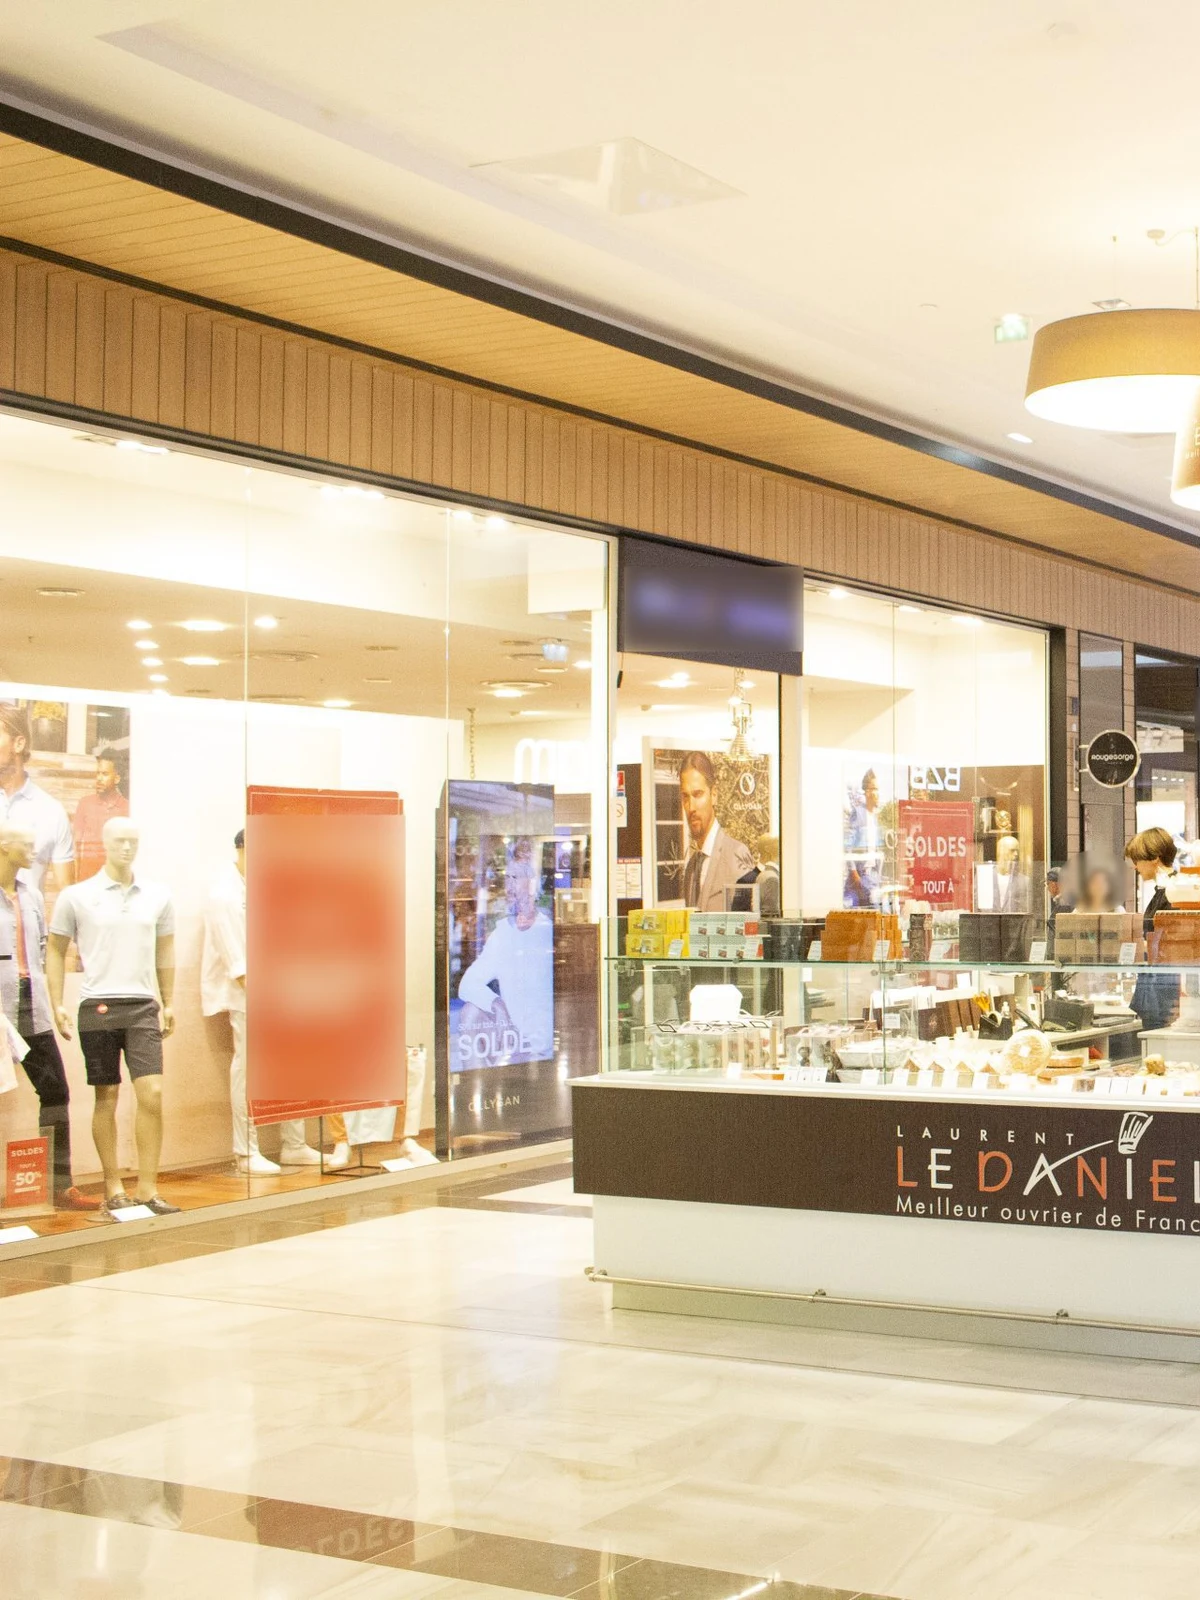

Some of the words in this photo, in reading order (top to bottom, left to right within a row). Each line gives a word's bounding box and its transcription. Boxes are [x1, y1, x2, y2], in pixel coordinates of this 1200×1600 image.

[905, 836, 967, 858] SOLDES
[922, 880, 946, 894] TOUT
[896, 1125, 1074, 1146] LAURENT
[11, 1146, 44, 1157] SOLDES
[897, 1146, 954, 1190] LE
[896, 1195, 989, 1218] Meilleur
[1000, 1206, 1083, 1226] ouvrier
[1095, 1207, 1122, 1228] de
